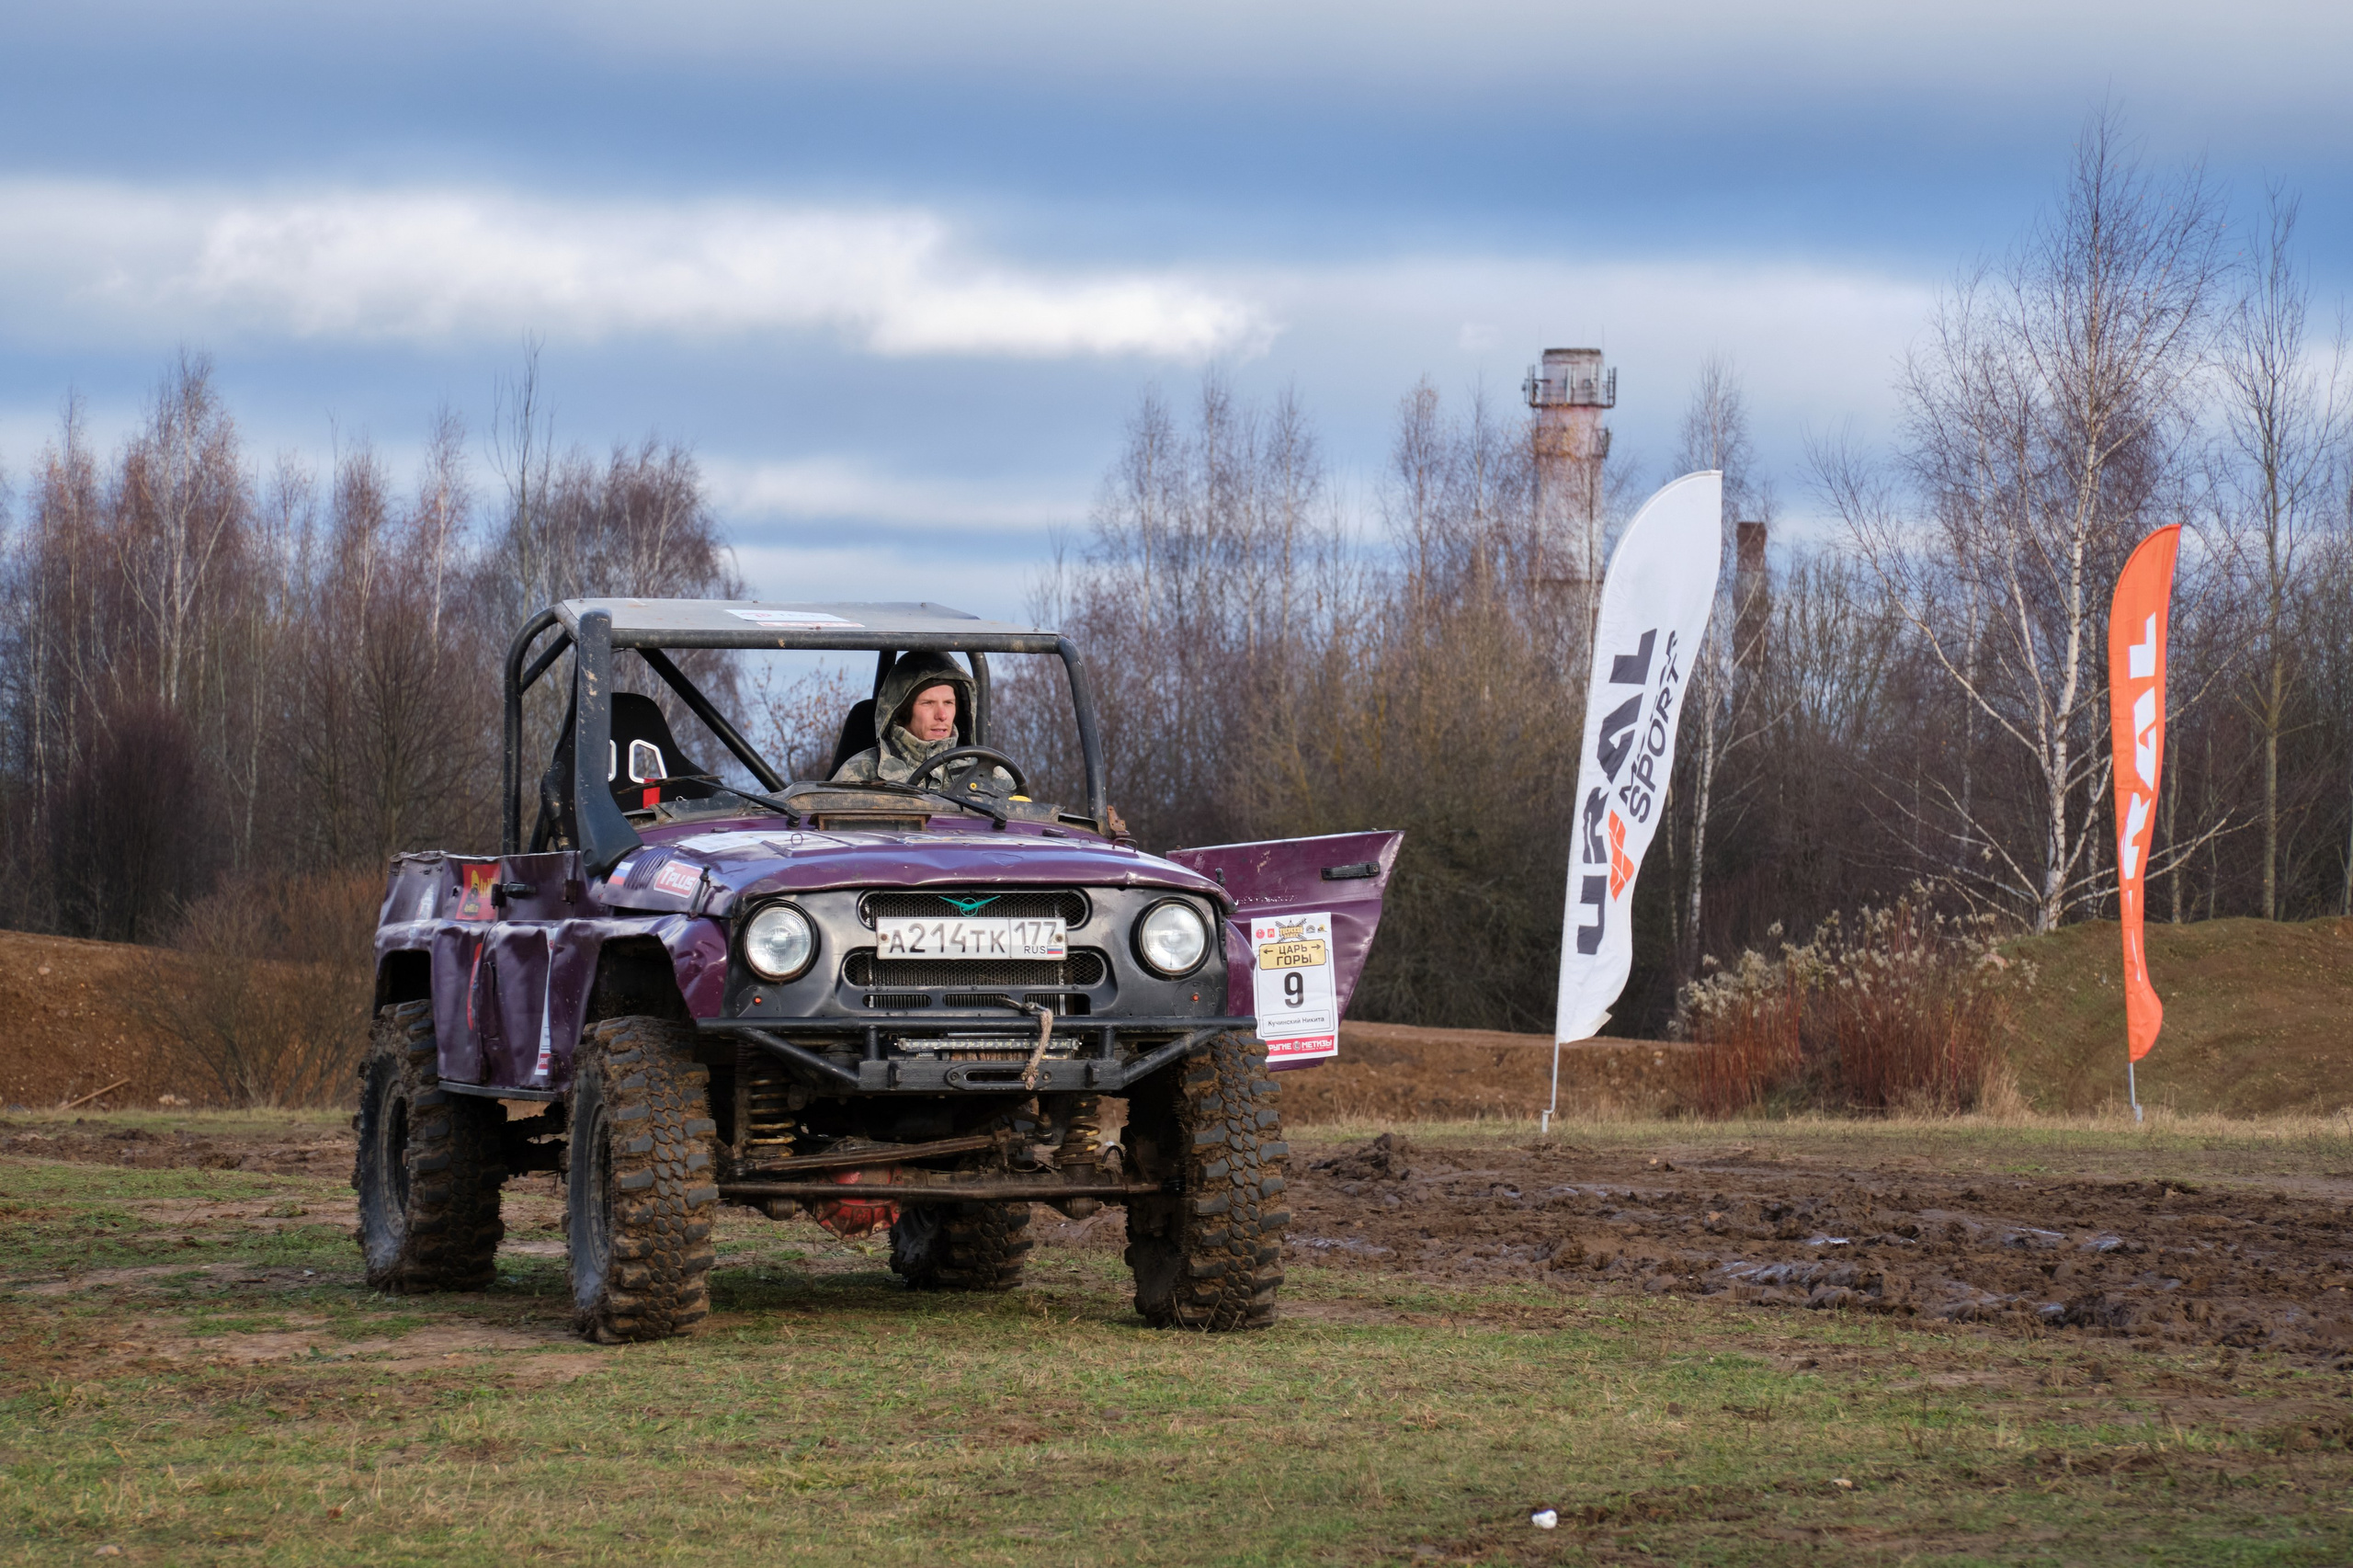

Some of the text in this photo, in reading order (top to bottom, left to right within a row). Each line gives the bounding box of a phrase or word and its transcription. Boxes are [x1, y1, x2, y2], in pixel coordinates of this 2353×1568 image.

[1630, 653, 1678, 824] SPORT
[1577, 629, 1657, 955] URAL
[2120, 611, 2157, 983] RAL
[1013, 921, 1057, 945] 177
[1024, 946, 1046, 954] RUS
[1279, 944, 1307, 955] ЦАРЬ
[1276, 954, 1313, 966] ГОРЫ
[1284, 971, 1304, 1008] 9
[1267, 1018, 1302, 1027] Кучинский
[1267, 1042, 1292, 1051] РУГИЕ
[1301, 1040, 1333, 1048] МЕТИЗЫ
